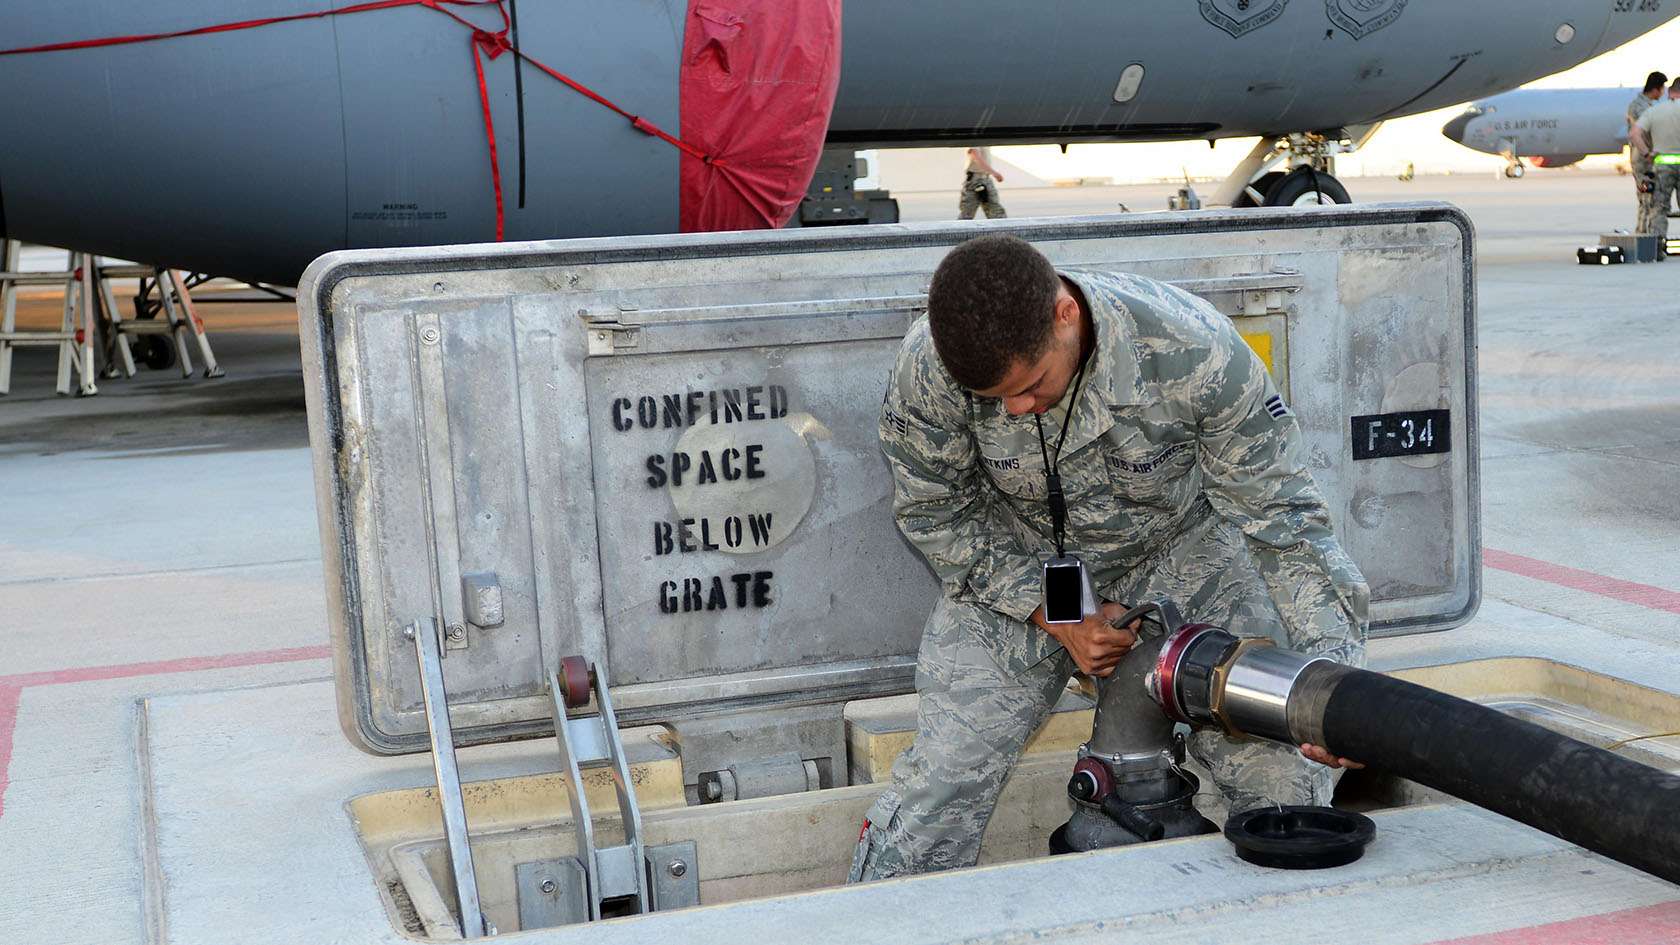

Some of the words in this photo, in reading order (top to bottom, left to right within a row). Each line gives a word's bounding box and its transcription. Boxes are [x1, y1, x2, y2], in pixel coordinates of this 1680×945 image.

[612, 385, 788, 431] CONFINED
[1368, 418, 1434, 451] F-34
[646, 444, 765, 488] SPACE
[1112, 456, 1132, 472] U.S.
[1132, 461, 1153, 474] AIR
[1152, 443, 1187, 469] FORCE
[654, 513, 772, 555] BELOW
[660, 571, 773, 614] GRATE
